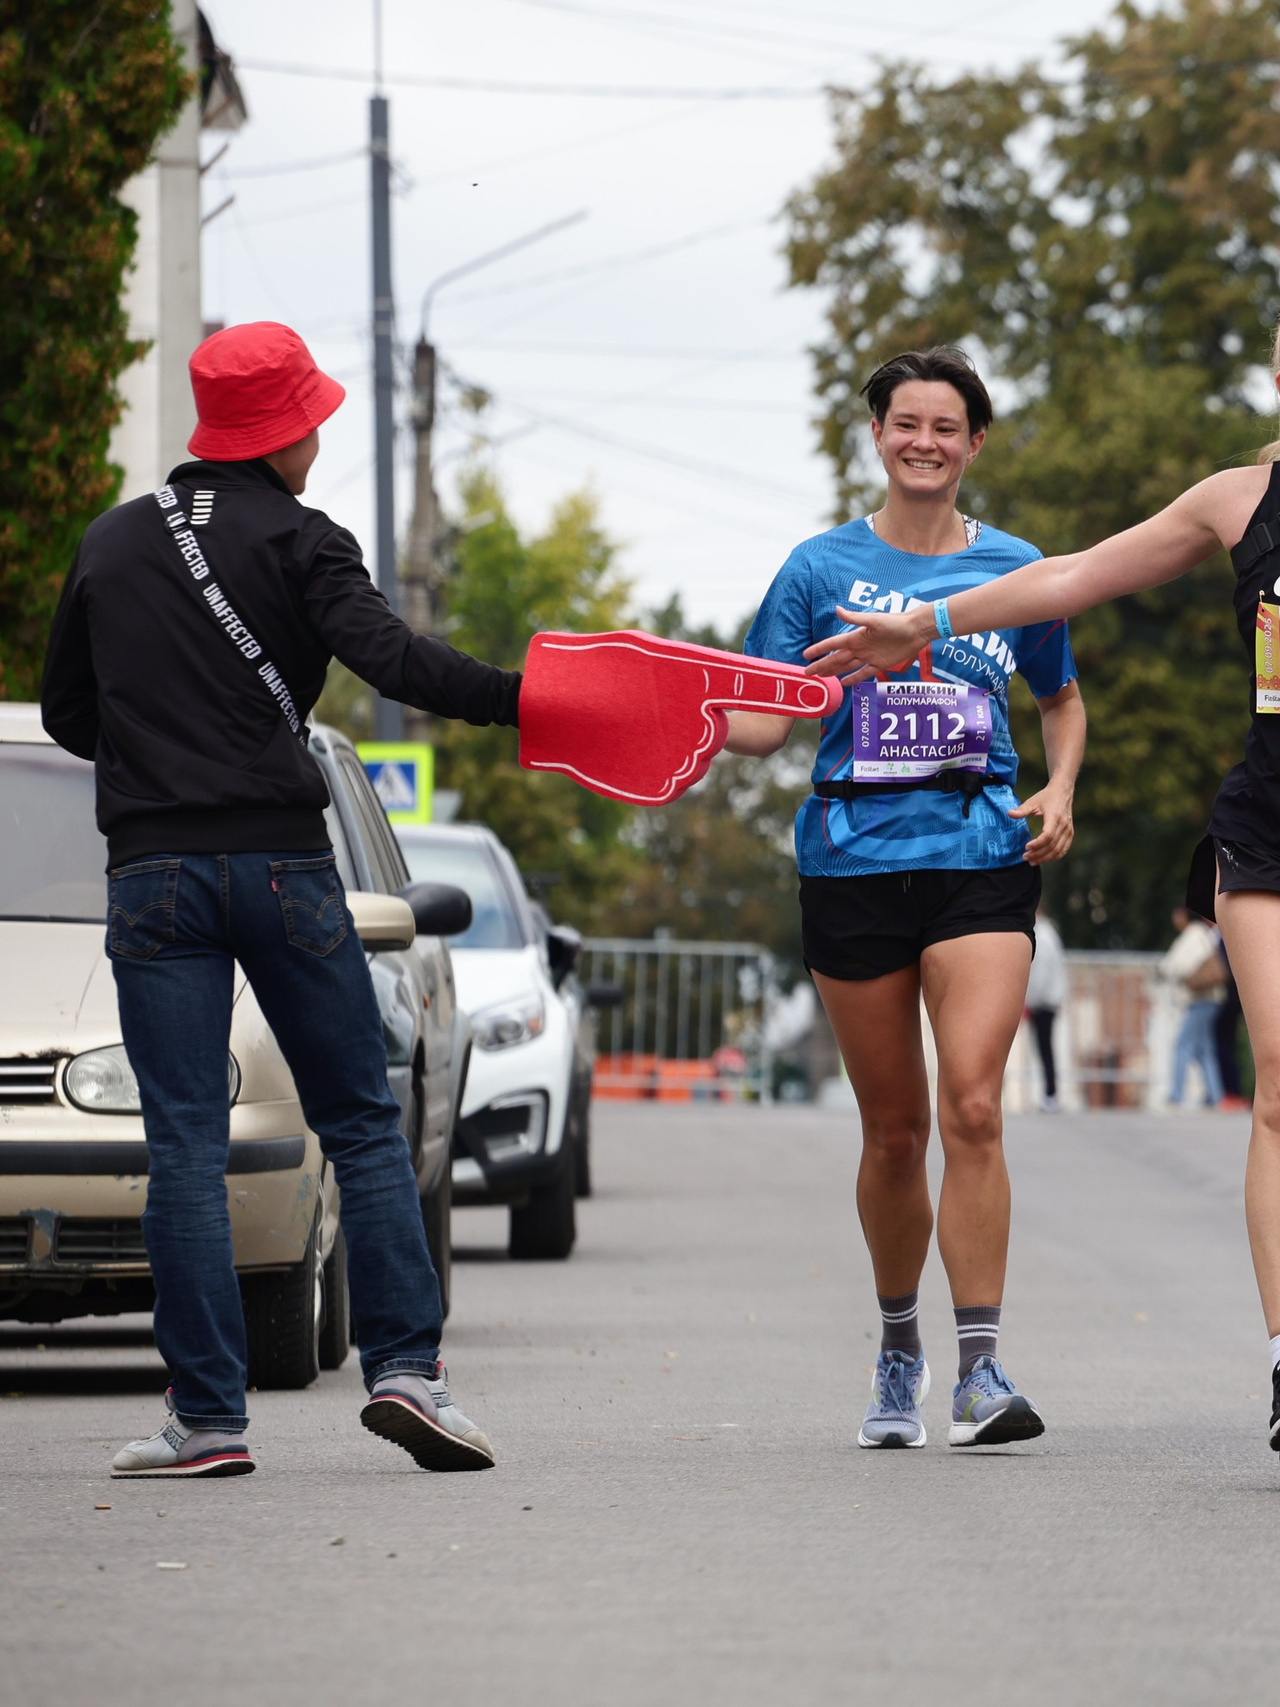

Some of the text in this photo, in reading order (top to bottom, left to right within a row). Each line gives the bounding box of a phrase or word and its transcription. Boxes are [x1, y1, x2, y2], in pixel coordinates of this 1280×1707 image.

[202, 582, 262, 660] UNAFFECTED
[257, 661, 300, 733] UNAFFECTED
[1264, 617, 1273, 674] 07.09.2025
[886, 684, 957, 697] ЕЛЕЦКИЙ
[886, 697, 957, 707] ПОЛУМАРАФОН
[860, 695, 870, 748] 07.09.2025
[879, 712, 966, 741] 2112
[975, 720, 986, 742] 21,1
[879, 742, 965, 758] АНАСТАСИЯ
